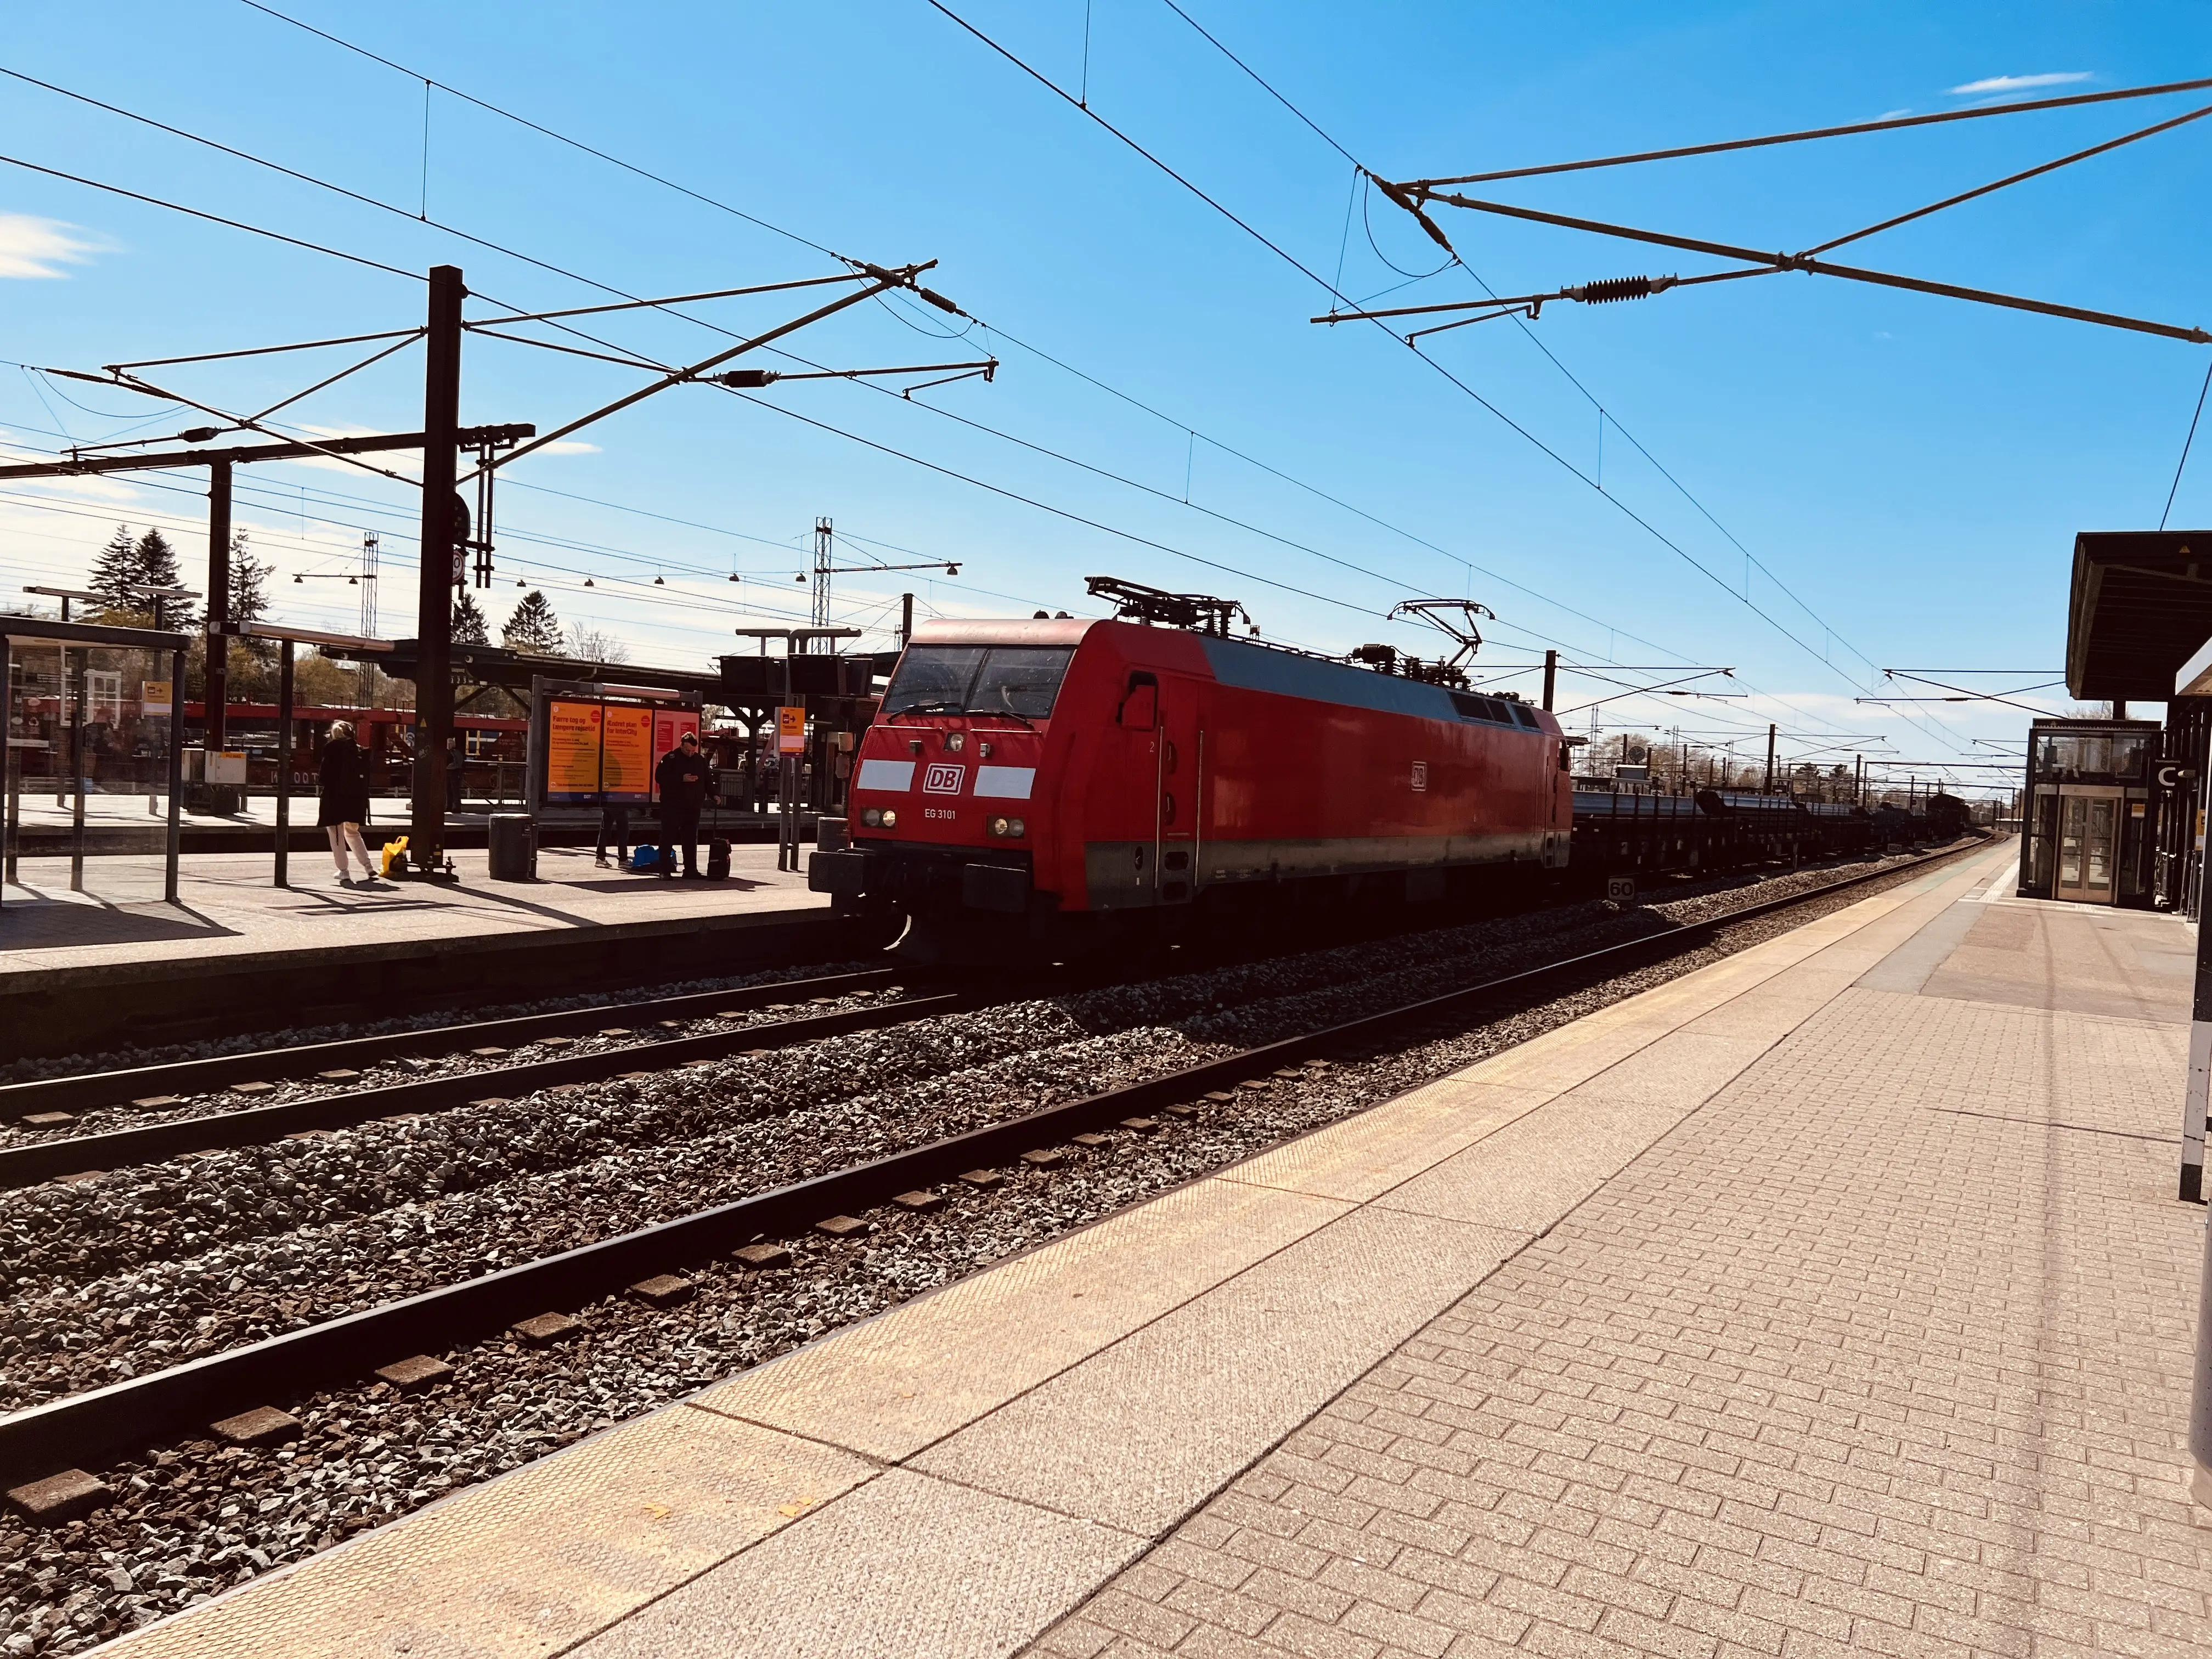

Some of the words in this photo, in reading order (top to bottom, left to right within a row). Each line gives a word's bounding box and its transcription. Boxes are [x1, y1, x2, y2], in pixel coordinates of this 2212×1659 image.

[552, 723, 574, 731] længere
[615, 728, 637, 736] InterCity
[930, 770, 957, 788] DB
[2158, 766, 2176, 787] C
[924, 808, 936, 818] EG
[937, 809, 956, 820] 3101
[1610, 882, 1634, 896] 60
